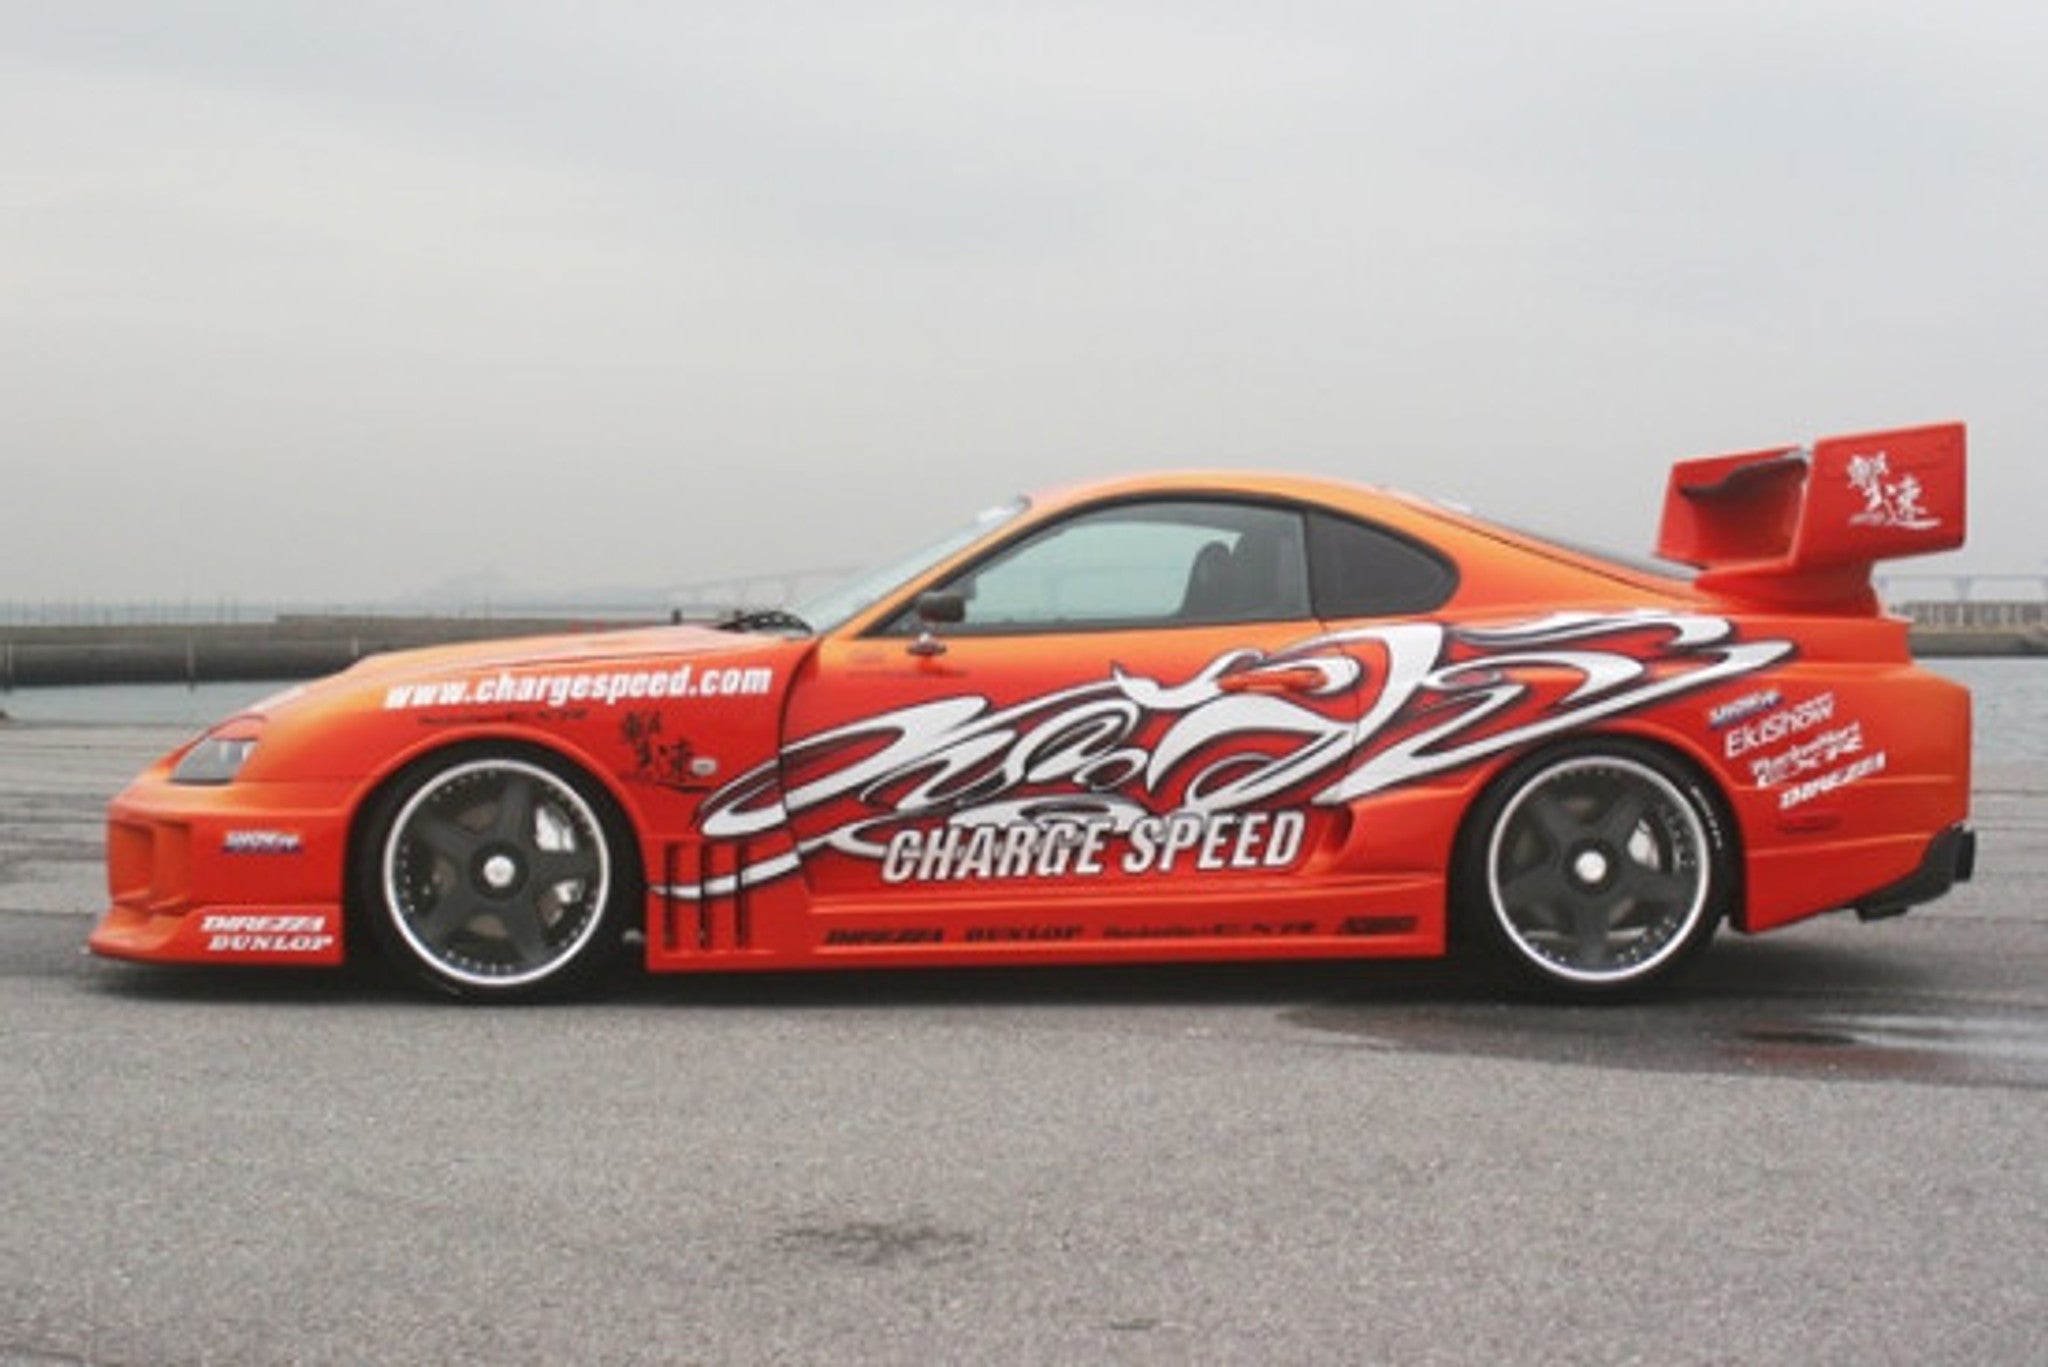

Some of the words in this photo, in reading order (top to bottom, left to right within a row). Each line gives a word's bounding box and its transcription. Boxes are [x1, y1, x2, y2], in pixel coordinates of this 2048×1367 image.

[385, 665, 772, 709] www.chargespeed.com
[882, 819, 1110, 882] CHARGE
[1122, 810, 1306, 874] SPEED
[208, 934, 333, 951] DUNLOP
